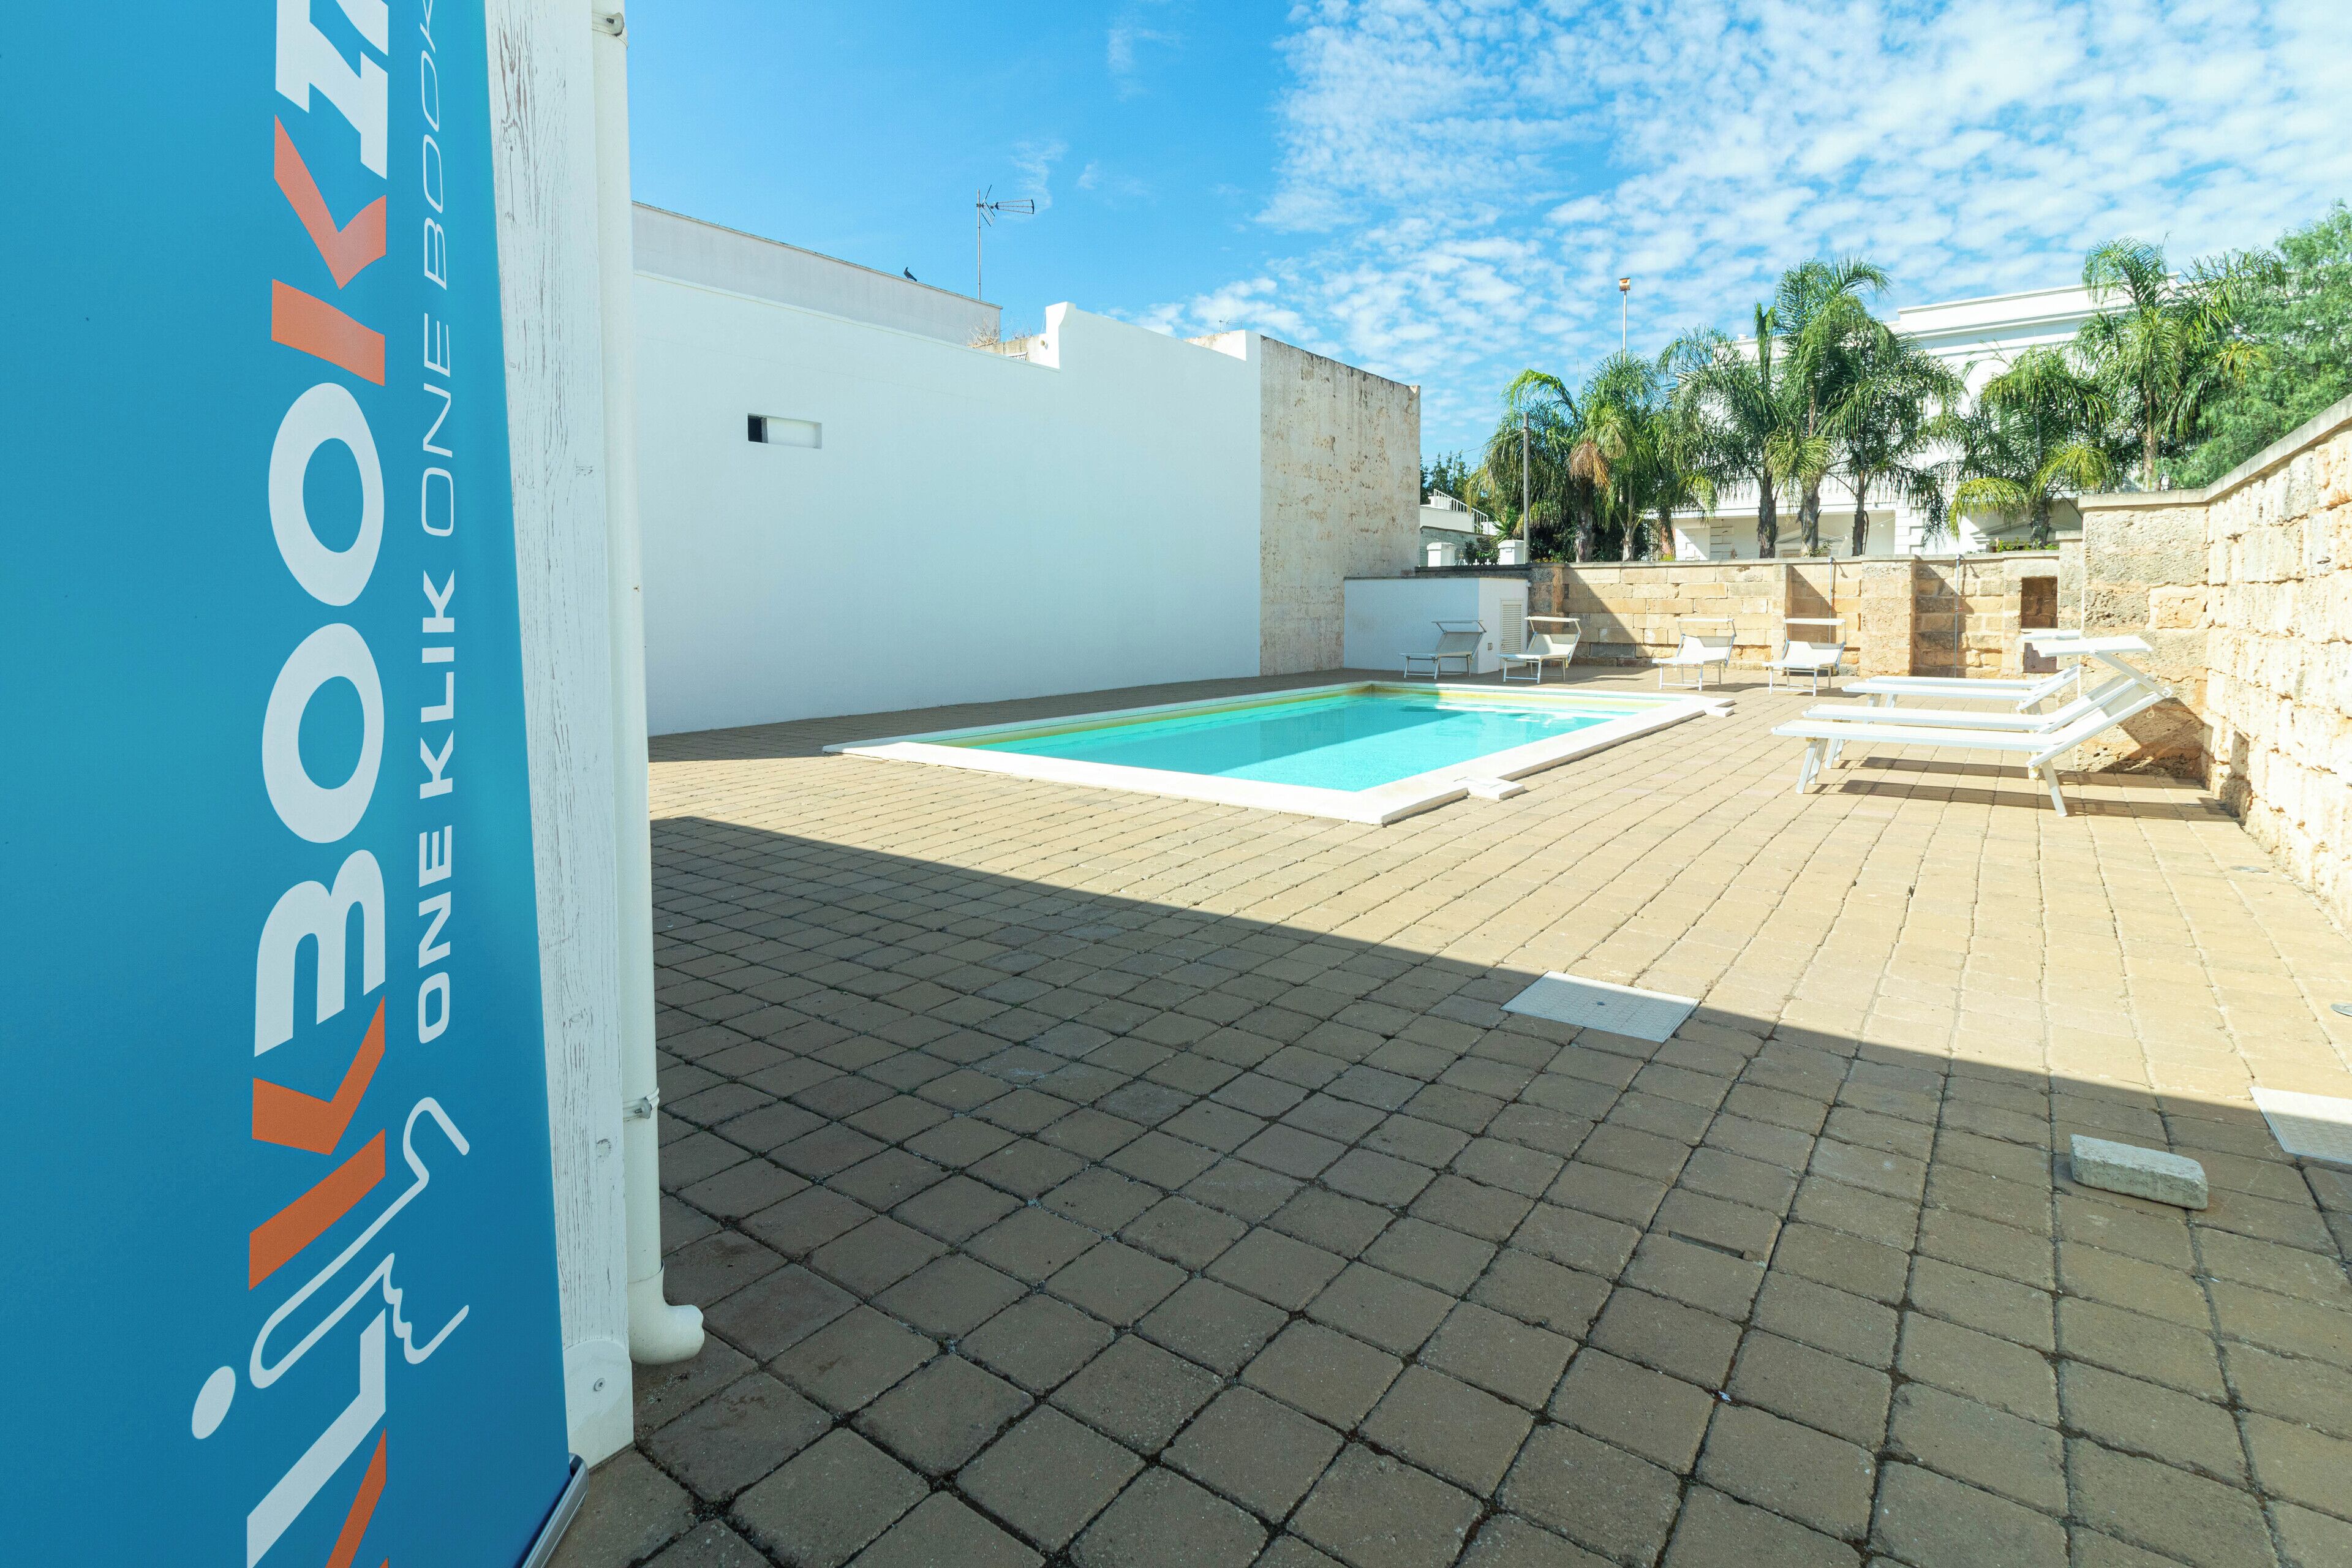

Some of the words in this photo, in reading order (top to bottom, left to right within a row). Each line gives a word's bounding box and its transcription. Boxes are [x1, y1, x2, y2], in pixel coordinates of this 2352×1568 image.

[421, 312, 454, 537] ONE
[420, 569, 454, 799] KLIK
[418, 824, 453, 1044] ONE
